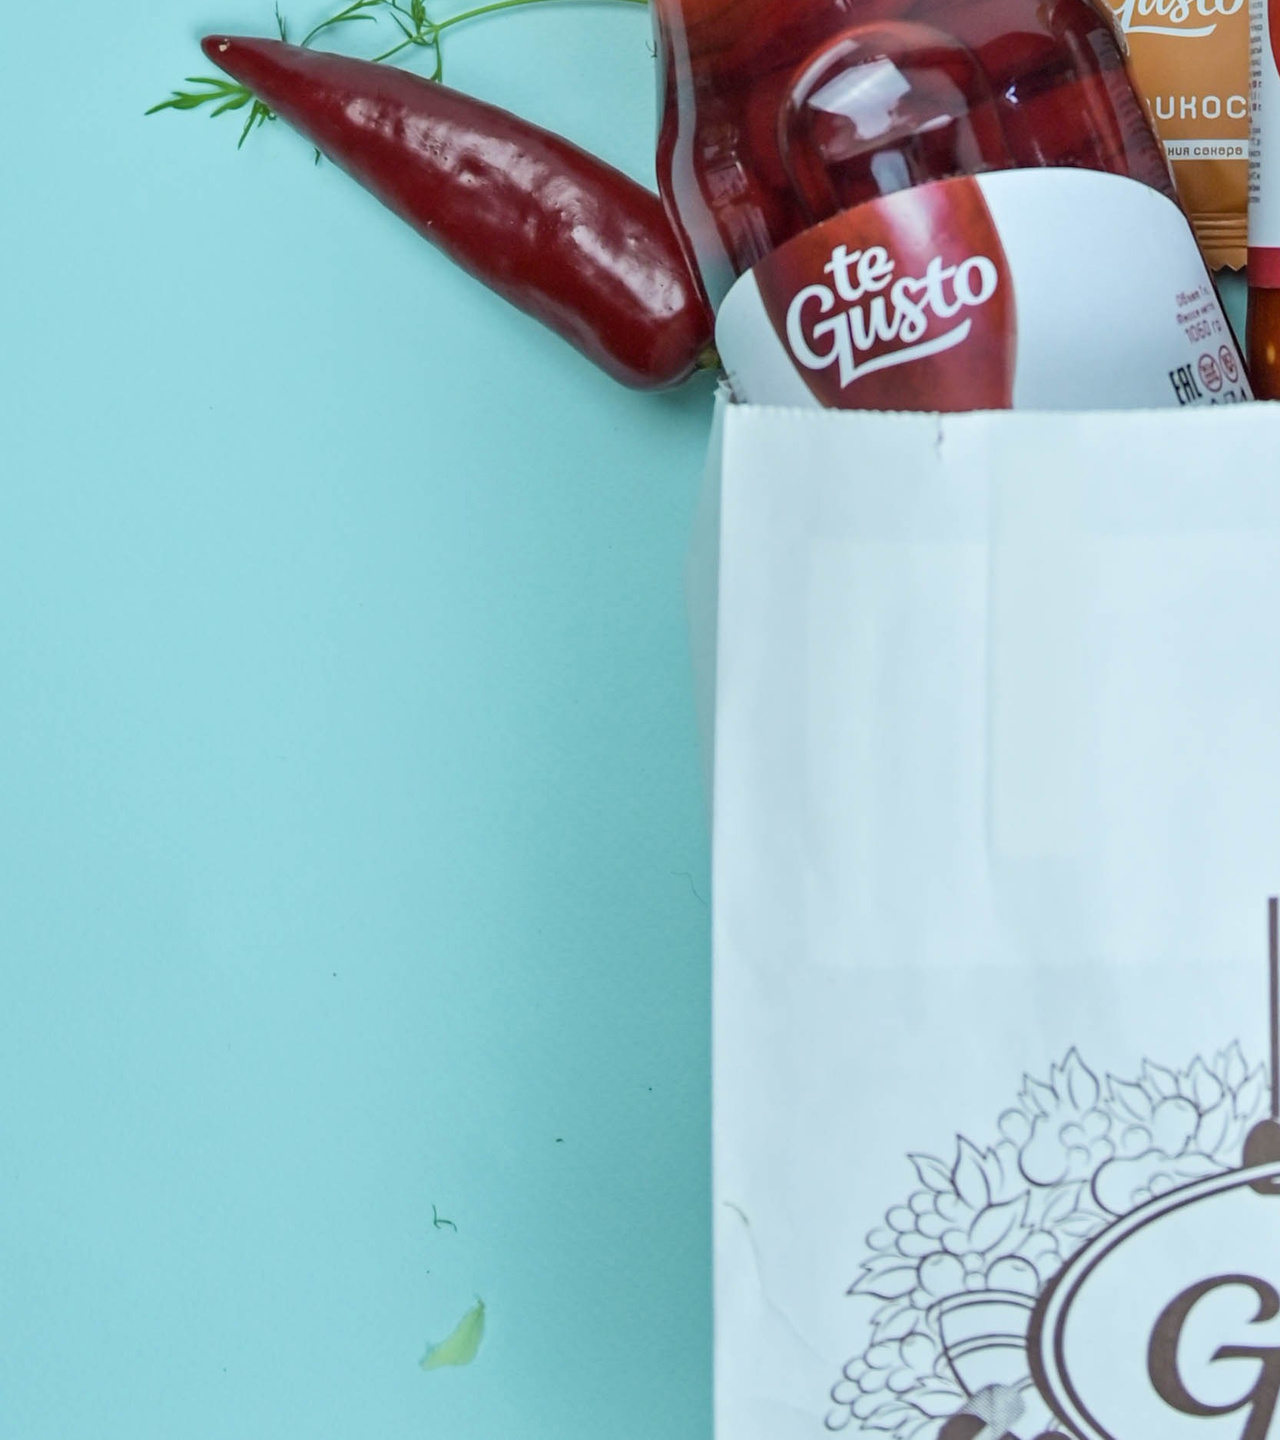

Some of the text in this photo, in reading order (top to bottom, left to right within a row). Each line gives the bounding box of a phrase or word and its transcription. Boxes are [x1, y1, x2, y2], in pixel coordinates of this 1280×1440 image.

[1154, 95, 1247, 120] ИКОС
[1167, 146, 1190, 157] ния
[823, 243, 896, 303] te
[785, 255, 999, 390] Gusto
